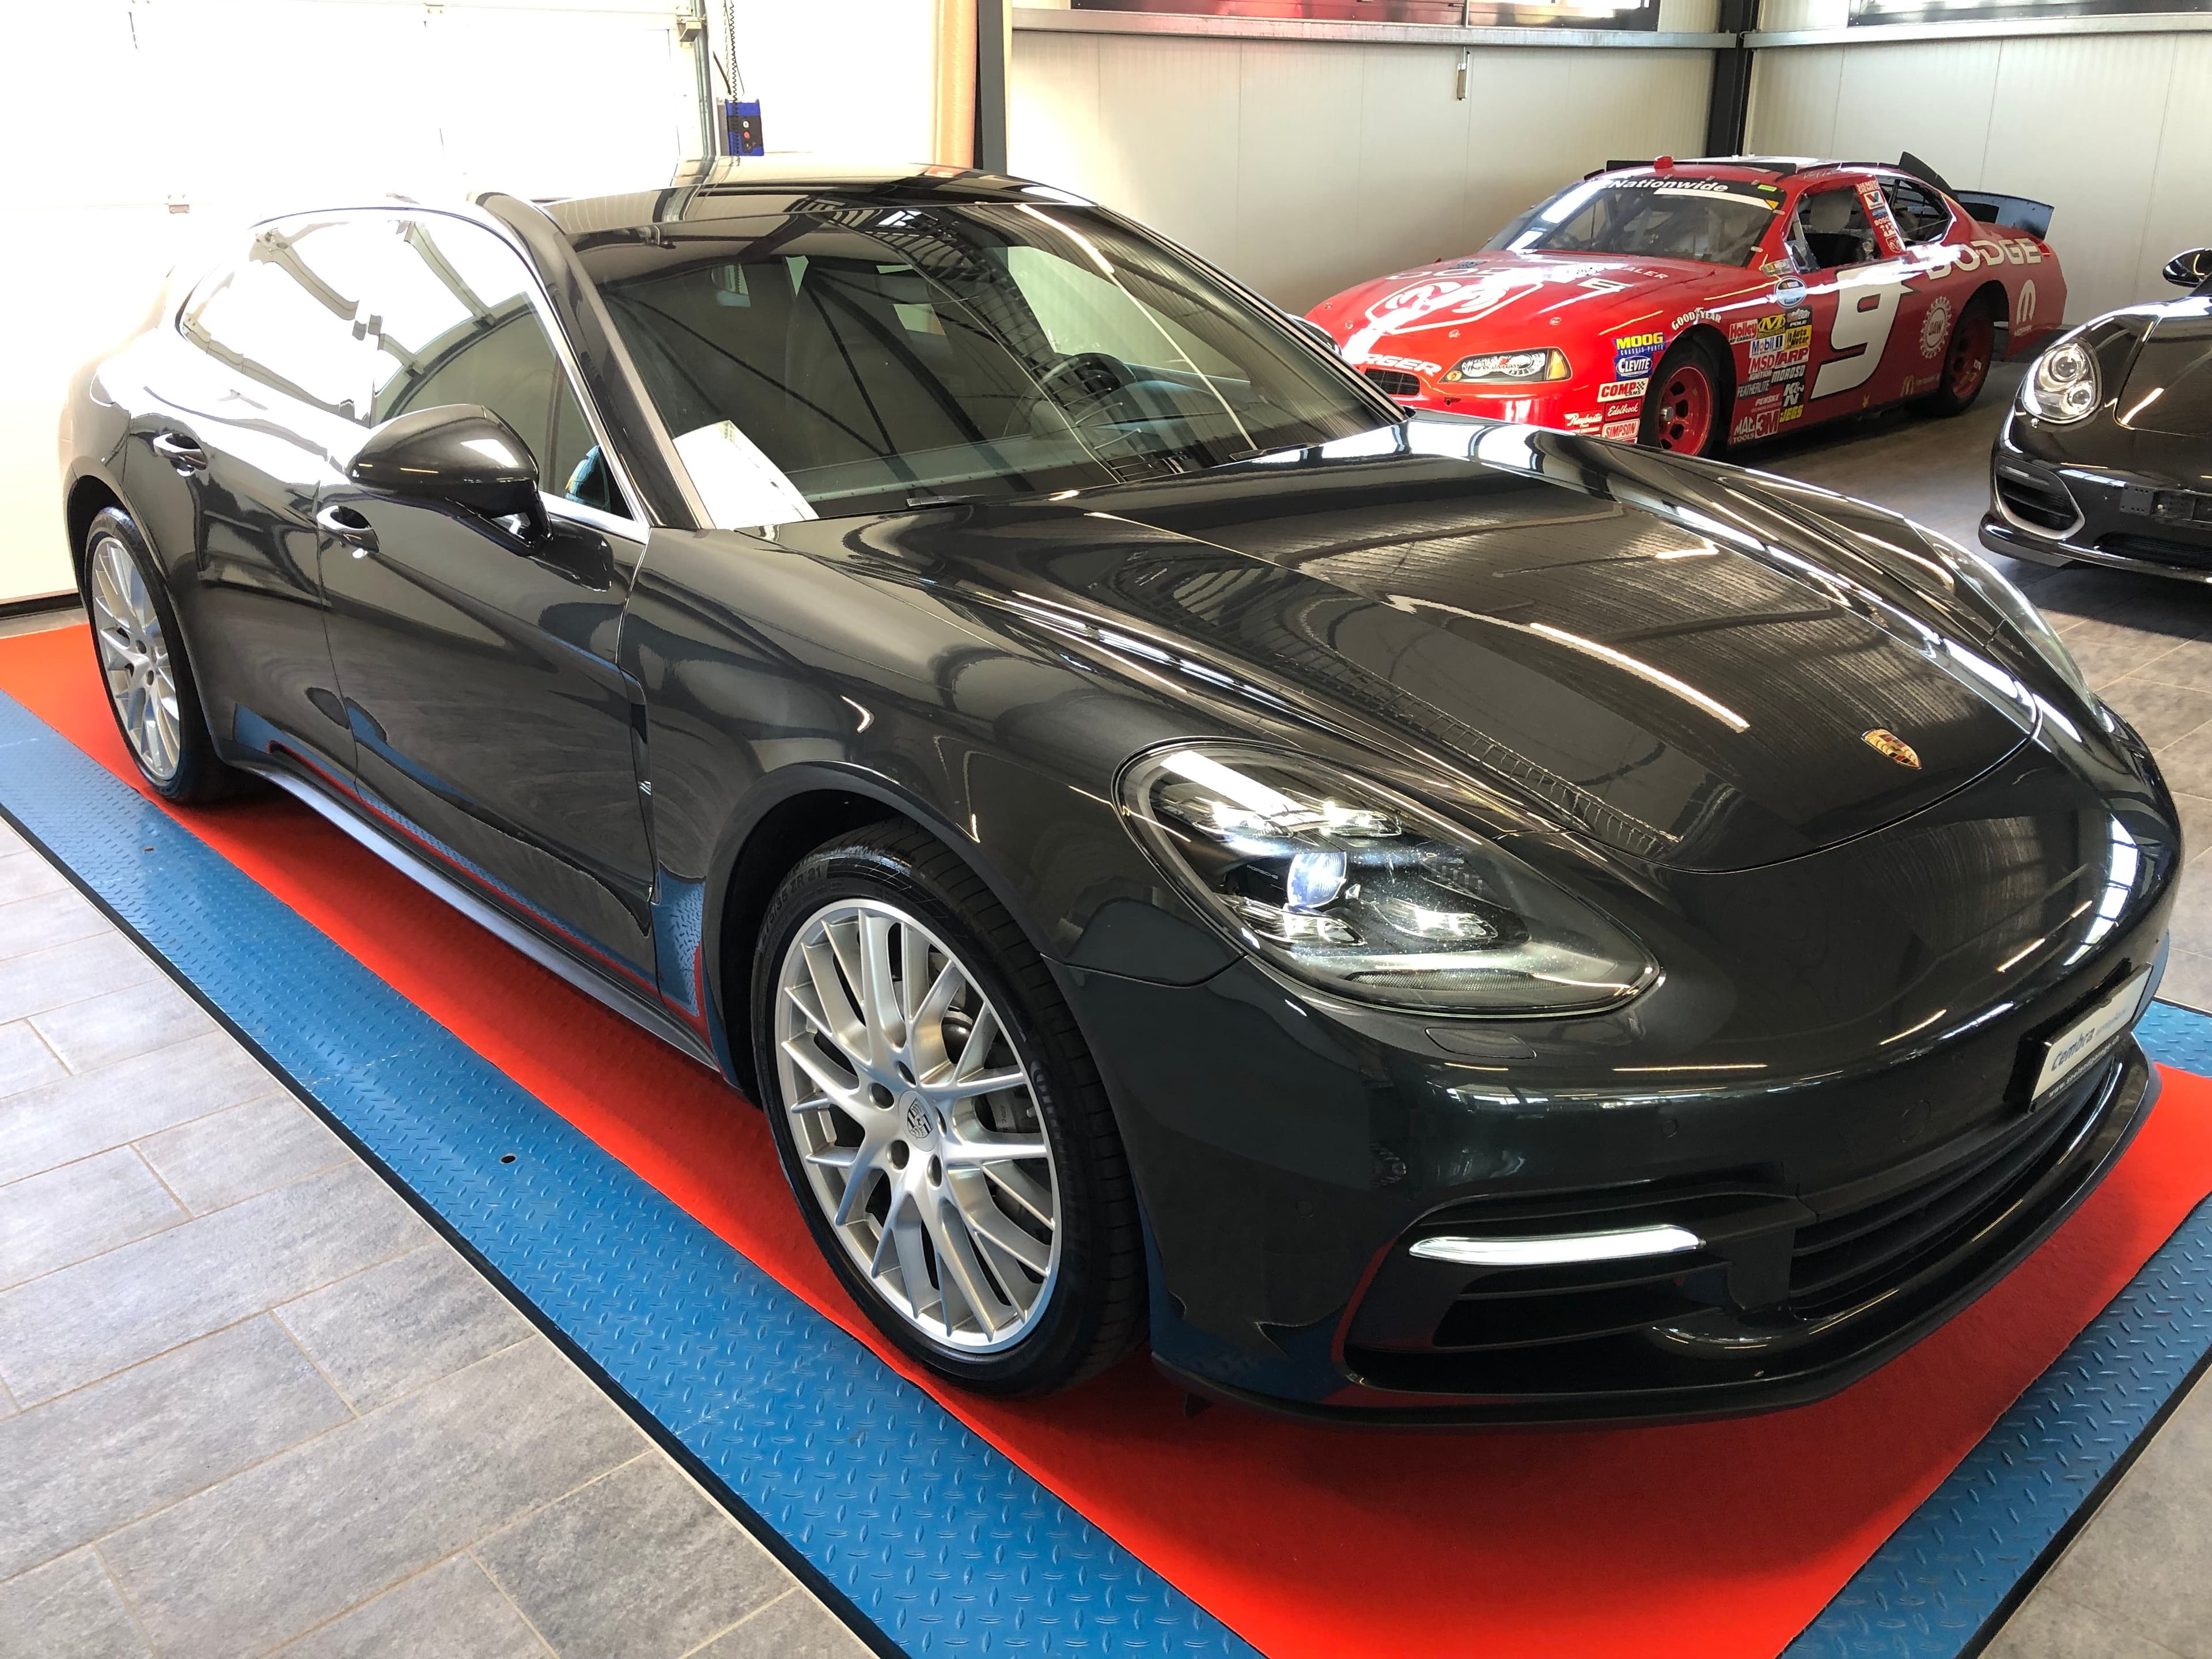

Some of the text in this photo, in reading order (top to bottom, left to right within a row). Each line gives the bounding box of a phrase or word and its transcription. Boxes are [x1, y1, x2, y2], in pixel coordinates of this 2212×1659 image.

[1608, 179, 1728, 192] Nationwide
[1874, 217, 1890, 226] BOSC
[1730, 323, 1757, 339] Holley
[1810, 257, 1904, 399] 9
[1616, 332, 1664, 350] MOOG
[1752, 337, 1774, 354] Mobil
[1776, 335, 1783, 348] 1
[1750, 354, 1775, 373] MSD
[1777, 347, 1809, 366] ARP
[1618, 358, 1650, 374] CLEVITE
[1601, 381, 1637, 397] COMP
[1608, 403, 1639, 417] Edelbrock
[1605, 422, 1637, 438] SIMPSON
[1733, 416, 1755, 435] MAC
[1756, 410, 1780, 437] 3M
[1733, 433, 1755, 444] TOOLS
